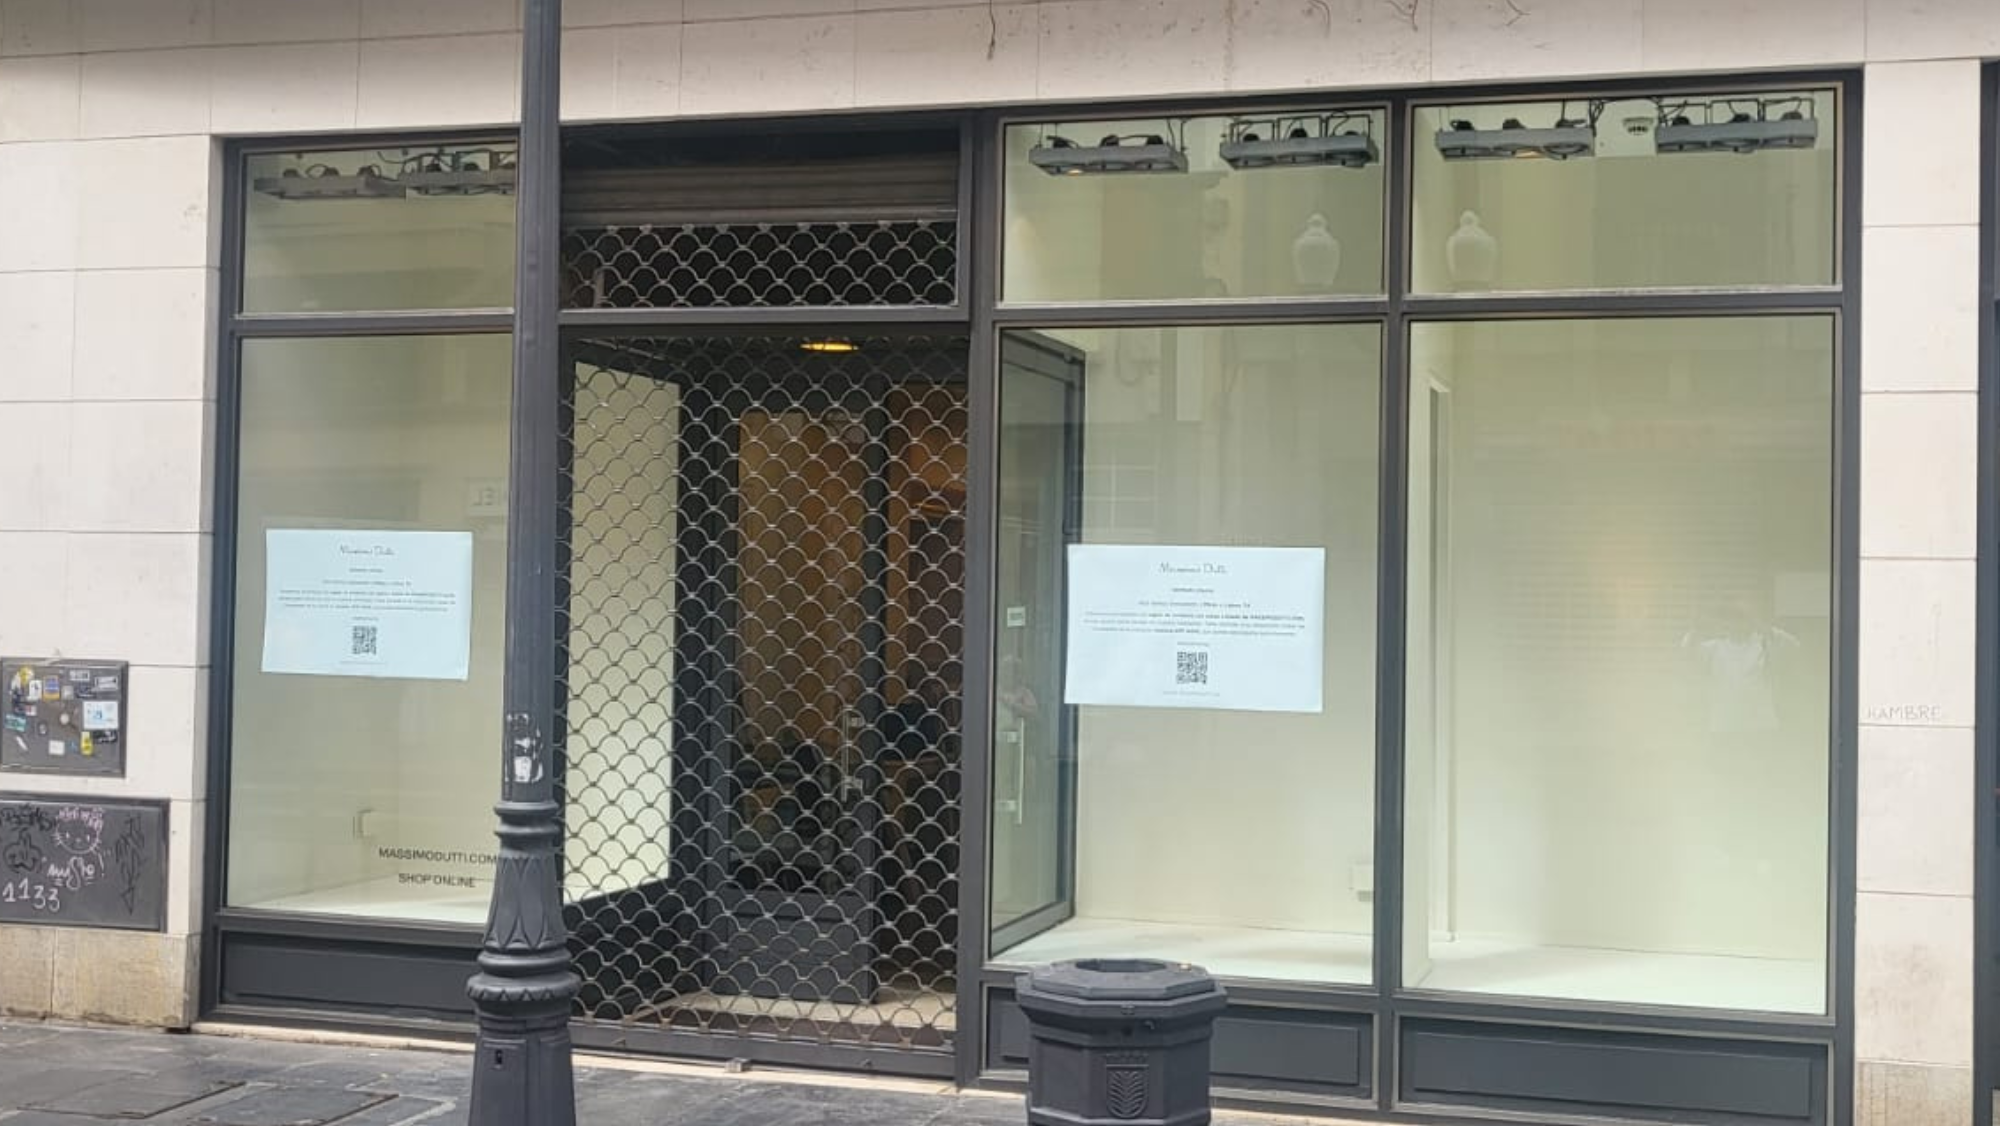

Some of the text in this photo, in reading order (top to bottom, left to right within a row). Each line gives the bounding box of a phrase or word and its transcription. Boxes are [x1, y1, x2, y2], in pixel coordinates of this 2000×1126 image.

[398, 872, 476, 888] SHOP ONLINE
[2, 877, 60, 912] 1133
